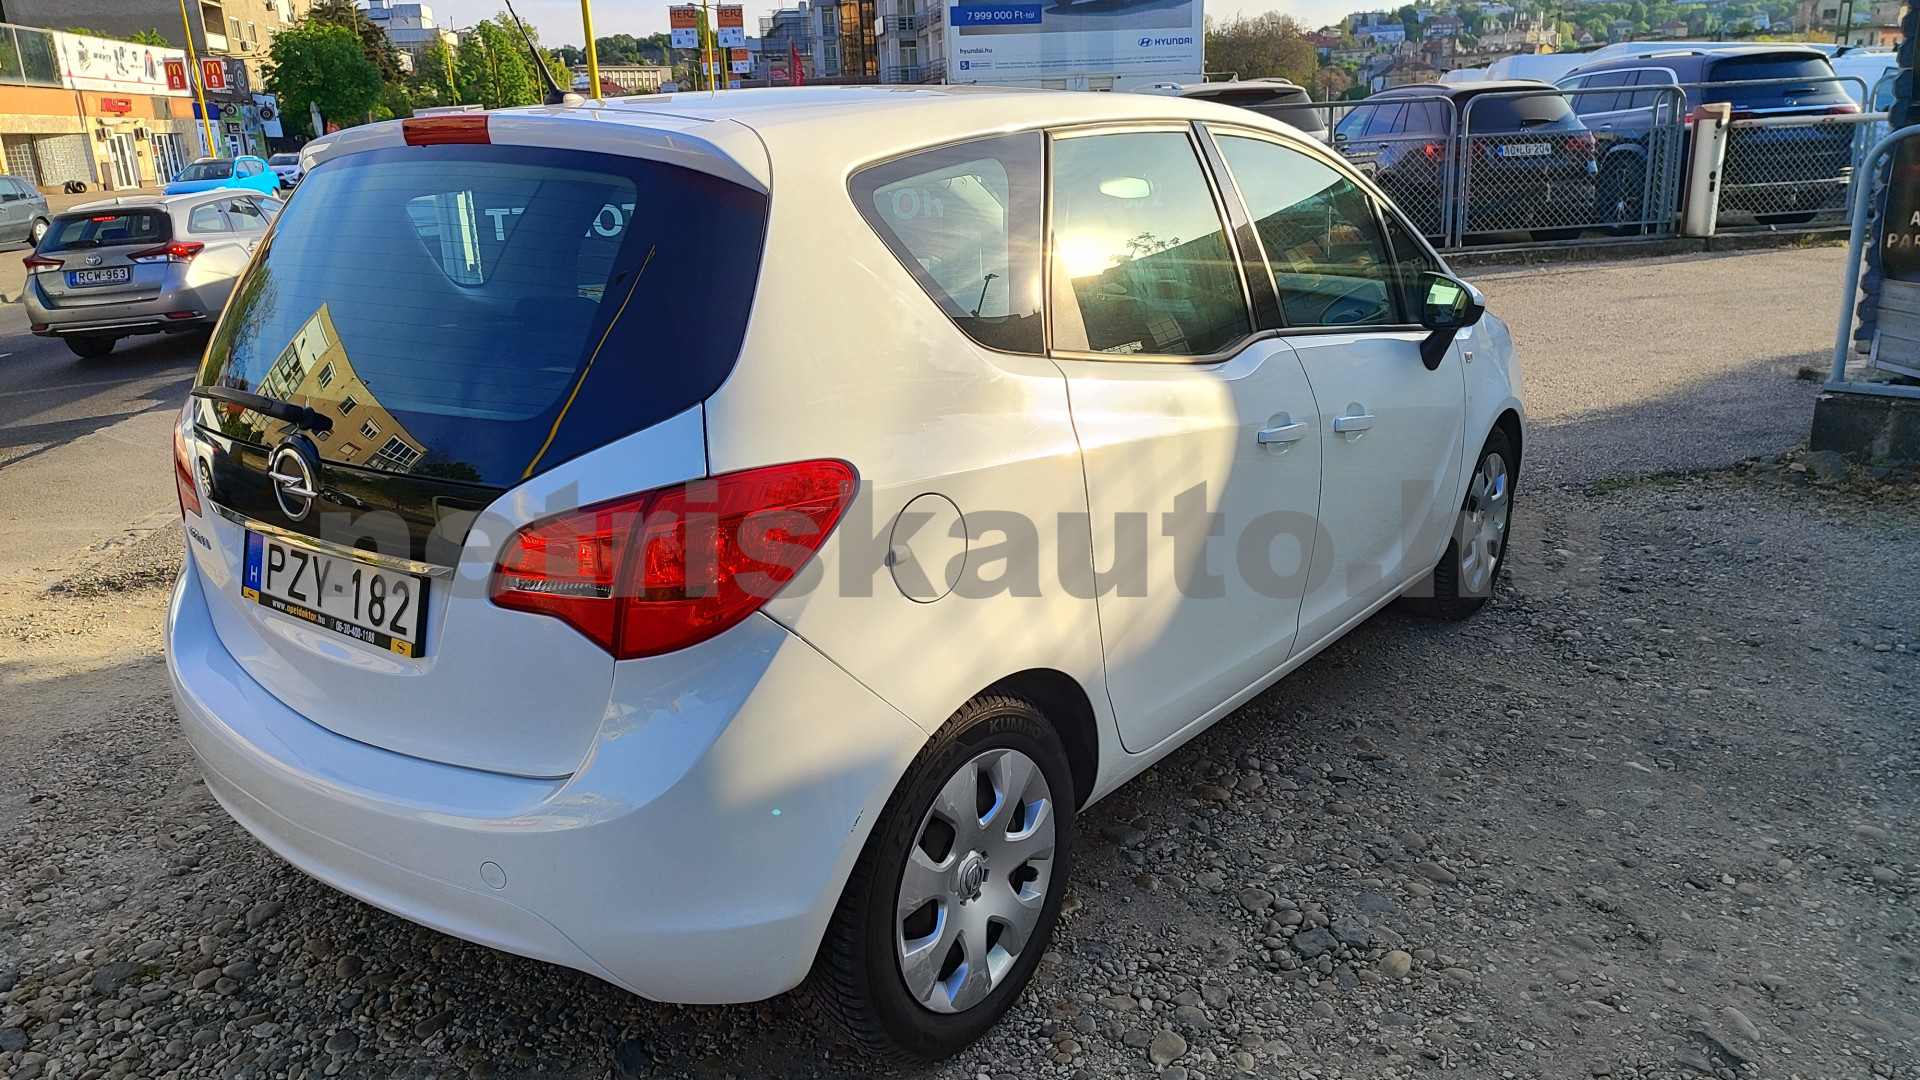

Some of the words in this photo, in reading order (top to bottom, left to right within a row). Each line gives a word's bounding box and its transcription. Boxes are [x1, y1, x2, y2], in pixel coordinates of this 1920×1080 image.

[670, 10, 696, 18] HERZ
[718, 9, 742, 18] HERZ
[966, 12, 972, 20] 7
[974, 12, 992, 20] 999
[994, 11, 1012, 20] 000
[1154, 37, 1192, 46] HYUNDAI
[78, 269, 126, 282] RCW-963
[250, 564, 258, 582] H
[266, 542, 410, 636] PZY-182
[272, 600, 326, 625] www.opeldoktor.hu
[988, 718, 1042, 740] KUMHO
